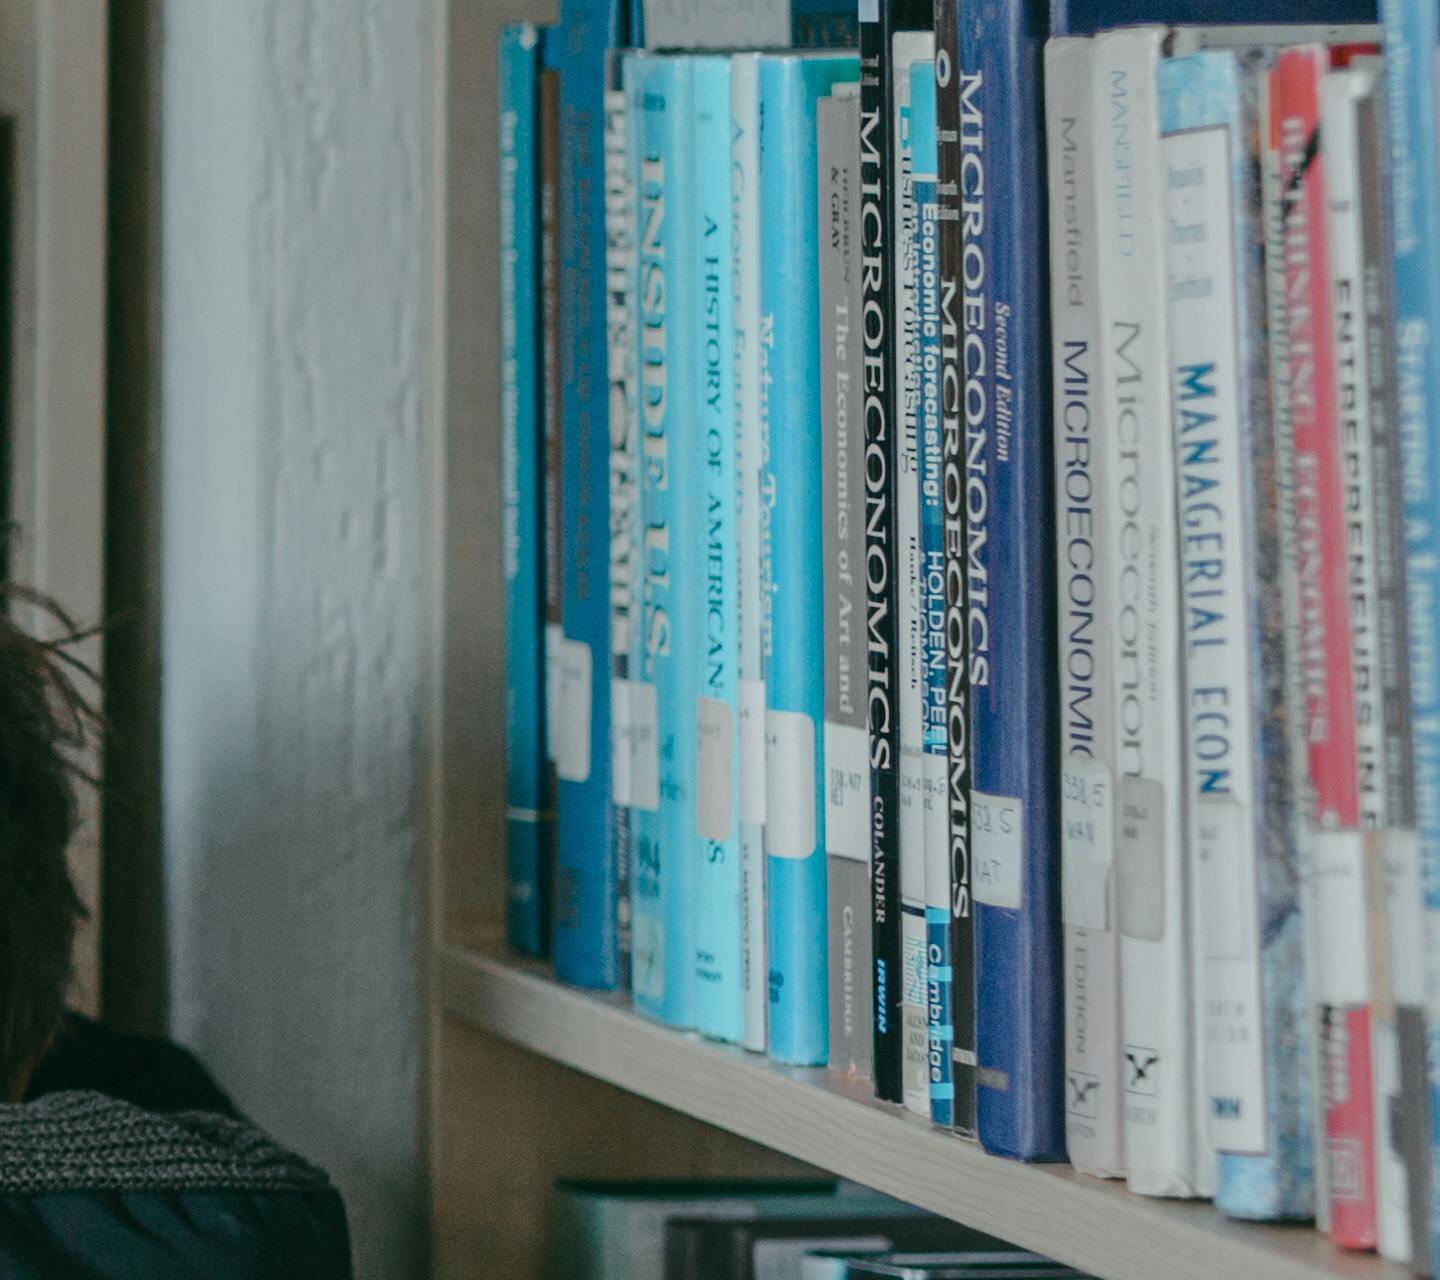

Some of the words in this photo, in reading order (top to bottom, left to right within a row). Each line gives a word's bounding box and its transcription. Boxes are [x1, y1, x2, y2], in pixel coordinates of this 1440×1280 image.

[922, 201, 939, 338] Economic
[1060, 116, 1084, 308] Mansfield
[639, 154, 670, 490] INSIDE
[704, 256, 722, 413] HISTORY
[835, 296, 850, 361] The
[959, 71, 989, 687] MICROECONOMICS
[994, 301, 1012, 378] Second
[706, 429, 722, 477] OF
[835, 370, 851, 540] Economics
[860, 108, 891, 770] MICROECONOMICS
[923, 345, 941, 509] forecasting:
[994, 384, 1014, 463] Edition
[836, 550, 852, 584] of
[1062, 339, 1094, 760] MICROECONOMIC
[1176, 361, 1228, 652] MANAGERIAL
[1333, 278, 1375, 728] ENTREPRENEURS
[1357, 746, 1377, 794] IN
[641, 519, 671, 673] U.S.
[707, 490, 726, 688] AMERICAN
[837, 592, 852, 646] Art
[927, 550, 946, 677] HOLDEN,
[939, 276, 970, 920] MICROECONOMICS
[838, 654, 854, 715] and
[873, 795, 887, 923] COLANDER
[875, 957, 888, 1034] IRWIN
[928, 943, 944, 1083] Cambridge
